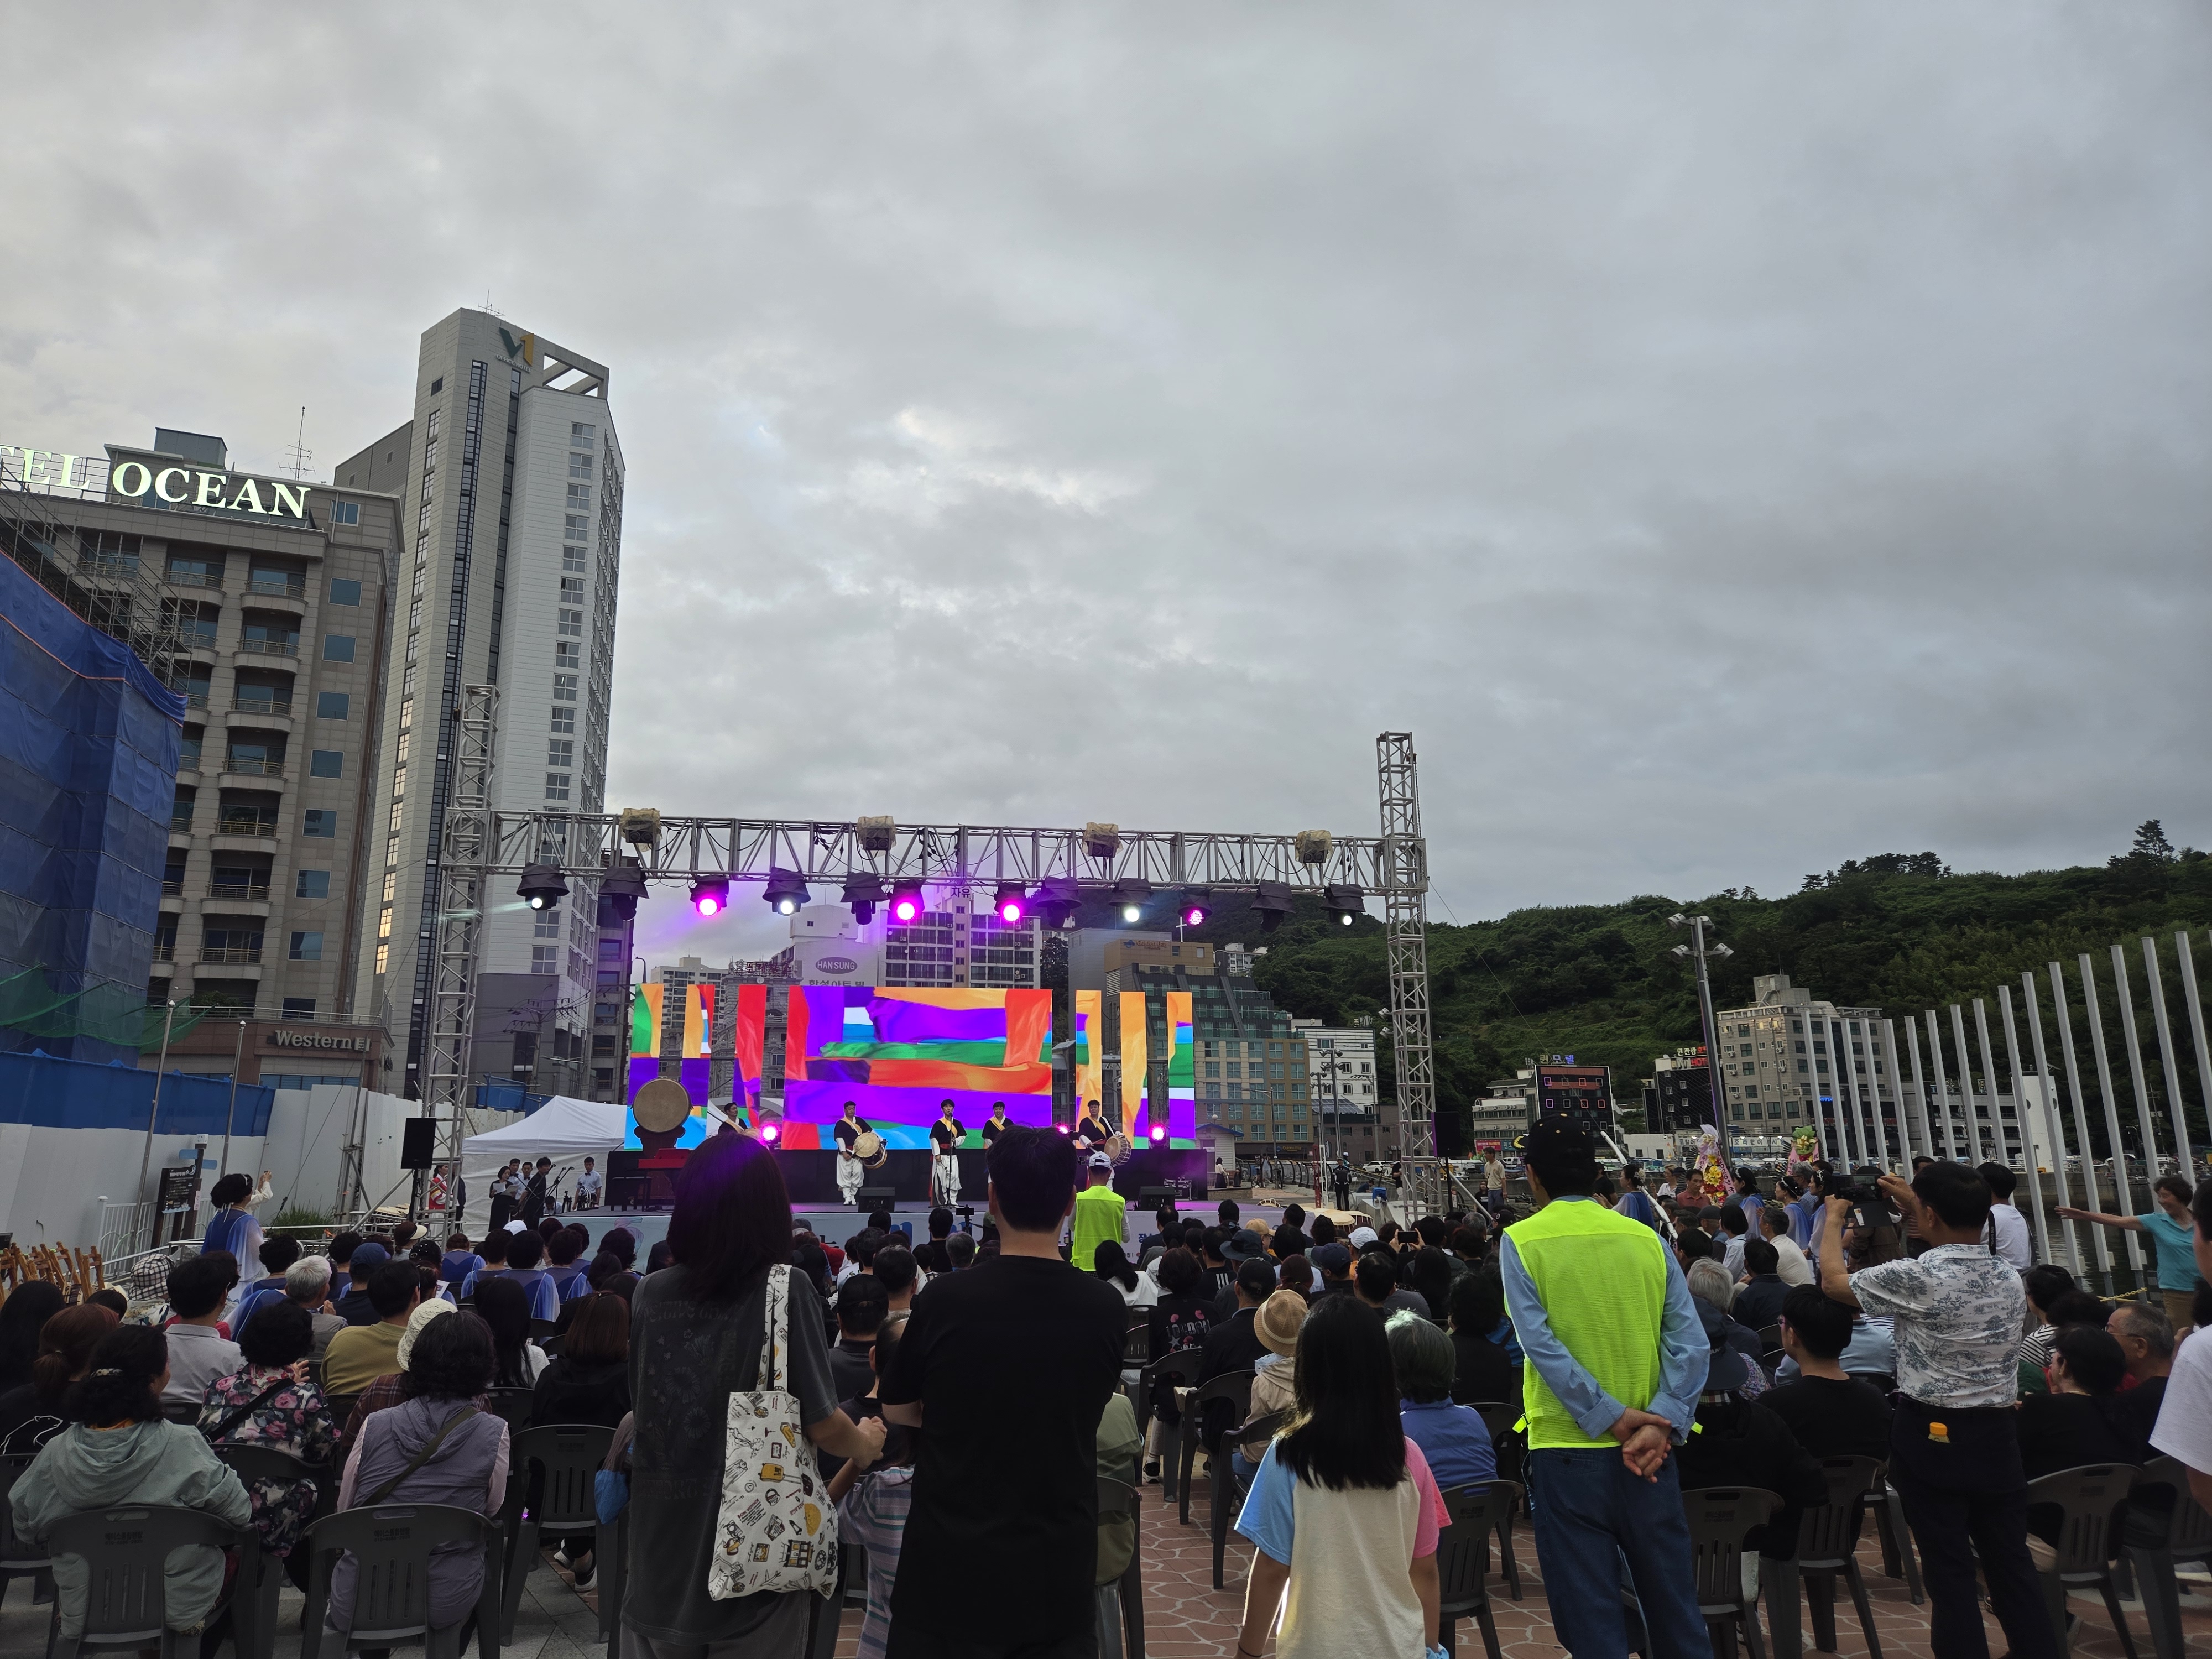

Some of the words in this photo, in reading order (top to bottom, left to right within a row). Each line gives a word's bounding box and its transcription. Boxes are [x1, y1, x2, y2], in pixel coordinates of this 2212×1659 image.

[497, 354, 515, 366] OFFICE
[515, 363, 531, 372] HOTEL
[112, 462, 311, 519] OCEAN
[951, 888, 971, 898] 자유
[817, 961, 855, 971] HANSUNG
[275, 1030, 352, 1050] Western
